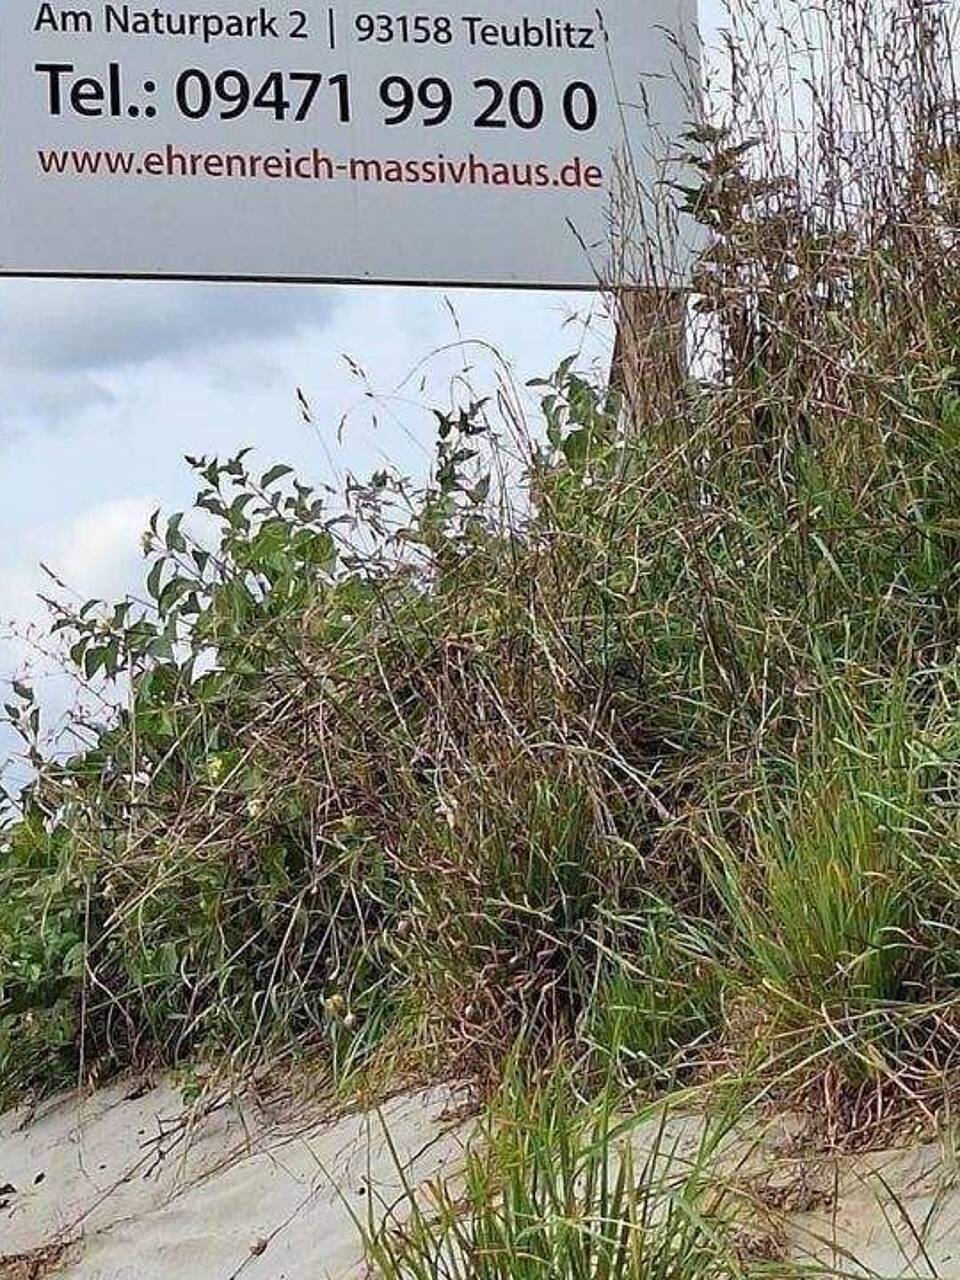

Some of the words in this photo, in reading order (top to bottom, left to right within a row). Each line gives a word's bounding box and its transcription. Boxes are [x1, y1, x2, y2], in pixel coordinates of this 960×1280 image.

[34, 3, 93, 34] Am
[105, 6, 279, 41] Naturpark
[289, 11, 308, 39] 2
[355, 14, 453, 45] 93158
[462, 16, 595, 50] Teublitz
[36, 63, 156, 119] Tel.:
[175, 68, 350, 123] 09471
[378, 75, 453, 128] 99
[473, 78, 543, 131] 20
[562, 80, 598, 131] 0
[39, 144, 603, 189] www.ehrenreich-massivhaus.de
